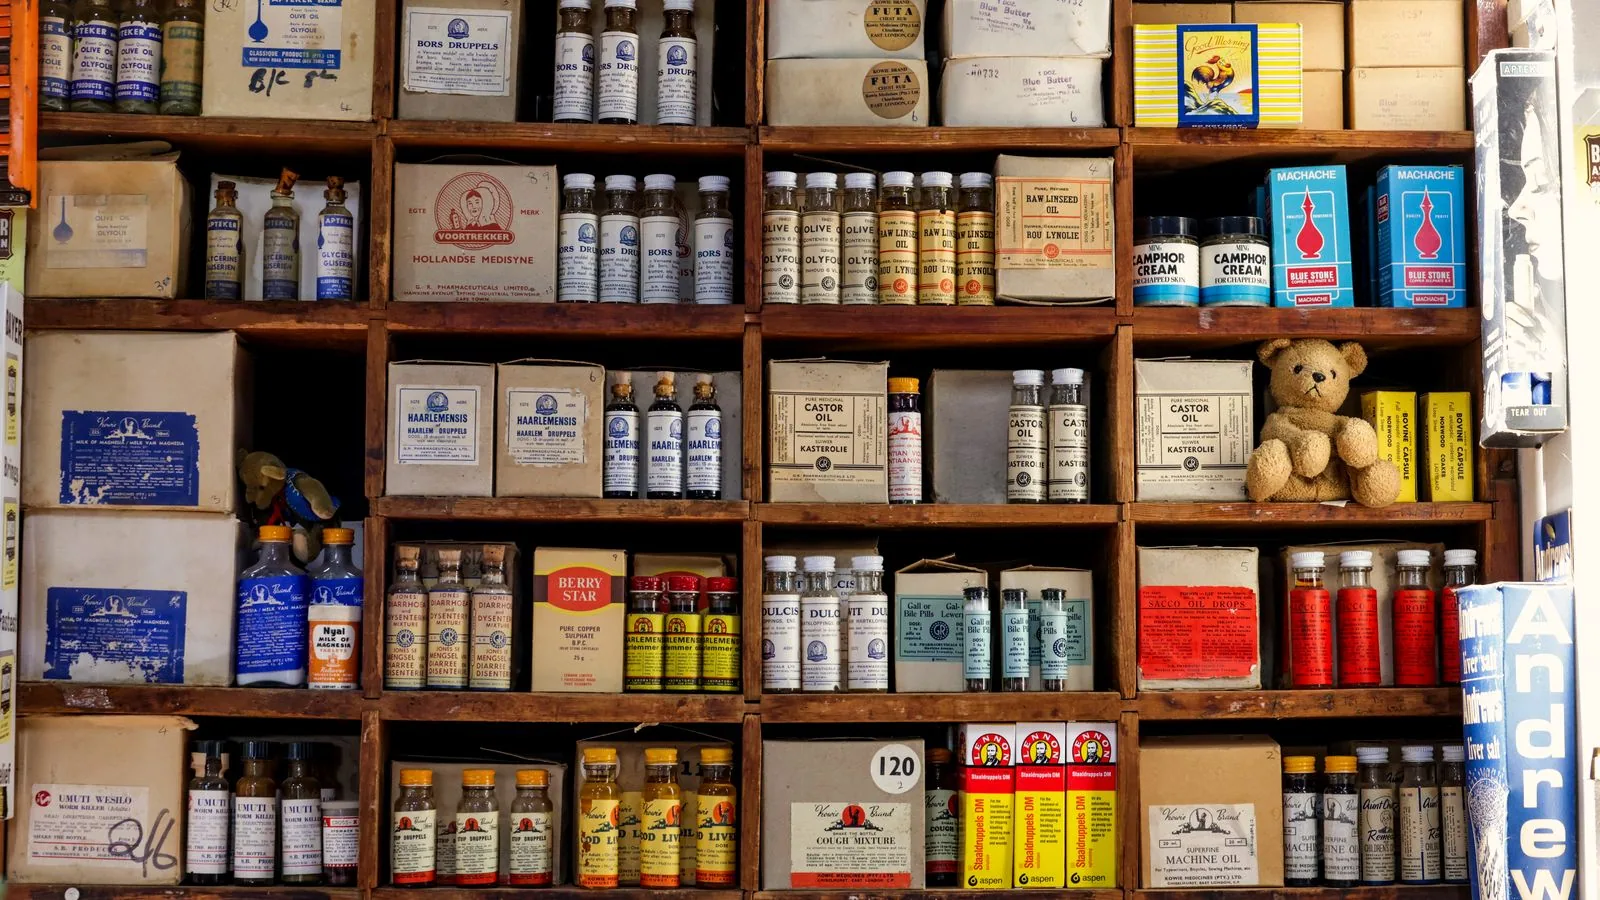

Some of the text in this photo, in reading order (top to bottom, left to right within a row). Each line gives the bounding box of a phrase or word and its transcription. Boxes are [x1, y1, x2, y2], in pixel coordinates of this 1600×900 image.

[873, 8, 912, 16] FUTA
[980, 2, 1031, 18] Blue Butter
[417, 40, 499, 51] BORS DRUPPELS
[1184, 36, 1250, 60] Good Morning
[80, 61, 113, 71] OLYFOLIE
[120, 62, 153, 71] OLYFOLIE
[871, 74, 912, 86] FUTA
[1047, 76, 1072, 84] Butter
[912, 110, 918, 121] 6
[1070, 111, 1077, 122] 6
[1278, 170, 1336, 181] MACHACHE
[1398, 171, 1455, 179] MACHACHE
[1046, 195, 1078, 203] LINSEED
[763, 225, 789, 233] OLIVE
[804, 225, 831, 233] OLIVE
[1046, 231, 1079, 240] LYNOLIE
[413, 255, 534, 264] HOLLANDSE MEDISYNE
[1133, 253, 1185, 265] CAMPHOR
[1214, 254, 1266, 265] CAMPHOR
[1138, 264, 1178, 276] CREAM
[1223, 265, 1262, 276] CREAM
[1290, 271, 1334, 280] BLUE STONE
[805, 403, 844, 412] CASTOR
[1170, 404, 1209, 413] CASTOR
[816, 414, 832, 422] OIL
[1511, 409, 1530, 417] TEAR
[408, 414, 468, 423] HAARLEMENSIS
[517, 416, 576, 426] HAARLEMENSIS
[1010, 420, 1043, 428] CASTOR
[1017, 429, 1033, 437] OIL
[1240, 562, 1249, 572] 5
[559, 578, 602, 588] BERRY
[563, 590, 597, 602] STAR
[324, 627, 345, 636] Nyal
[1463, 686, 1502, 725] Andrews
[974, 735, 1009, 761] LENNON
[1023, 734, 1059, 759] LENNON
[1074, 733, 1110, 759] LENNON
[1467, 736, 1484, 760] liver
[879, 756, 915, 776] 120
[59, 795, 132, 804] UMUTI WESILO
[238, 804, 266, 812] UMUTI
[284, 806, 312, 814] UMUTI
[974, 799, 986, 870] Staaldruppels DM
[1025, 797, 1036, 868] Staaldruppels DM
[1076, 796, 1087, 868] Staaldruppels DM
[854, 837, 896, 845] MIXTURE
[1166, 855, 1240, 864] MACHINE OIL
